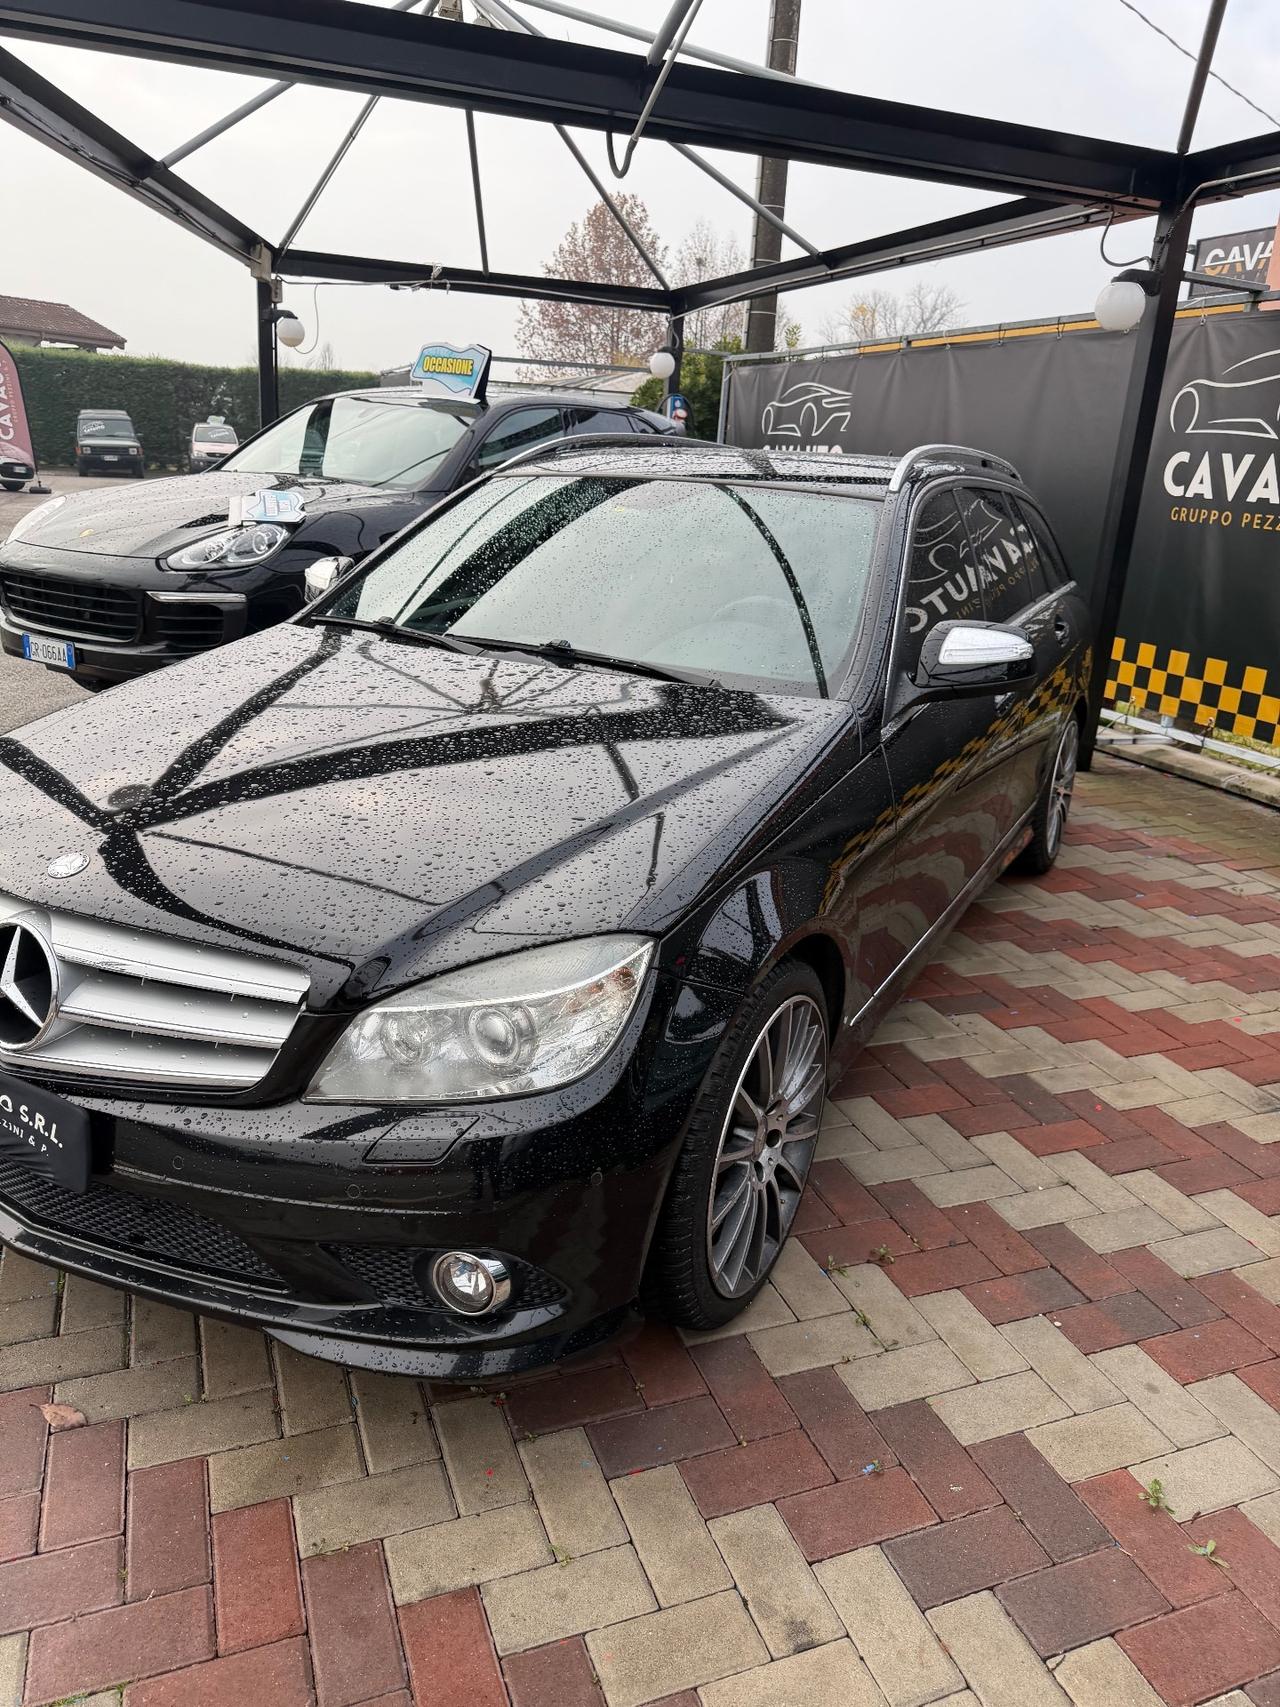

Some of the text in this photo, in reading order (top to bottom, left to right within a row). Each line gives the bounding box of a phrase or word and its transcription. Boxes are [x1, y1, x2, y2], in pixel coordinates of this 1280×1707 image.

[423, 355, 474, 376] OCCASIONE
[1163, 450, 1280, 504] CAVA
[1171, 506, 1232, 526] GRUPPO
[19, 1105, 63, 1149] S.R.L.
[28, 1135, 36, 1147] &
